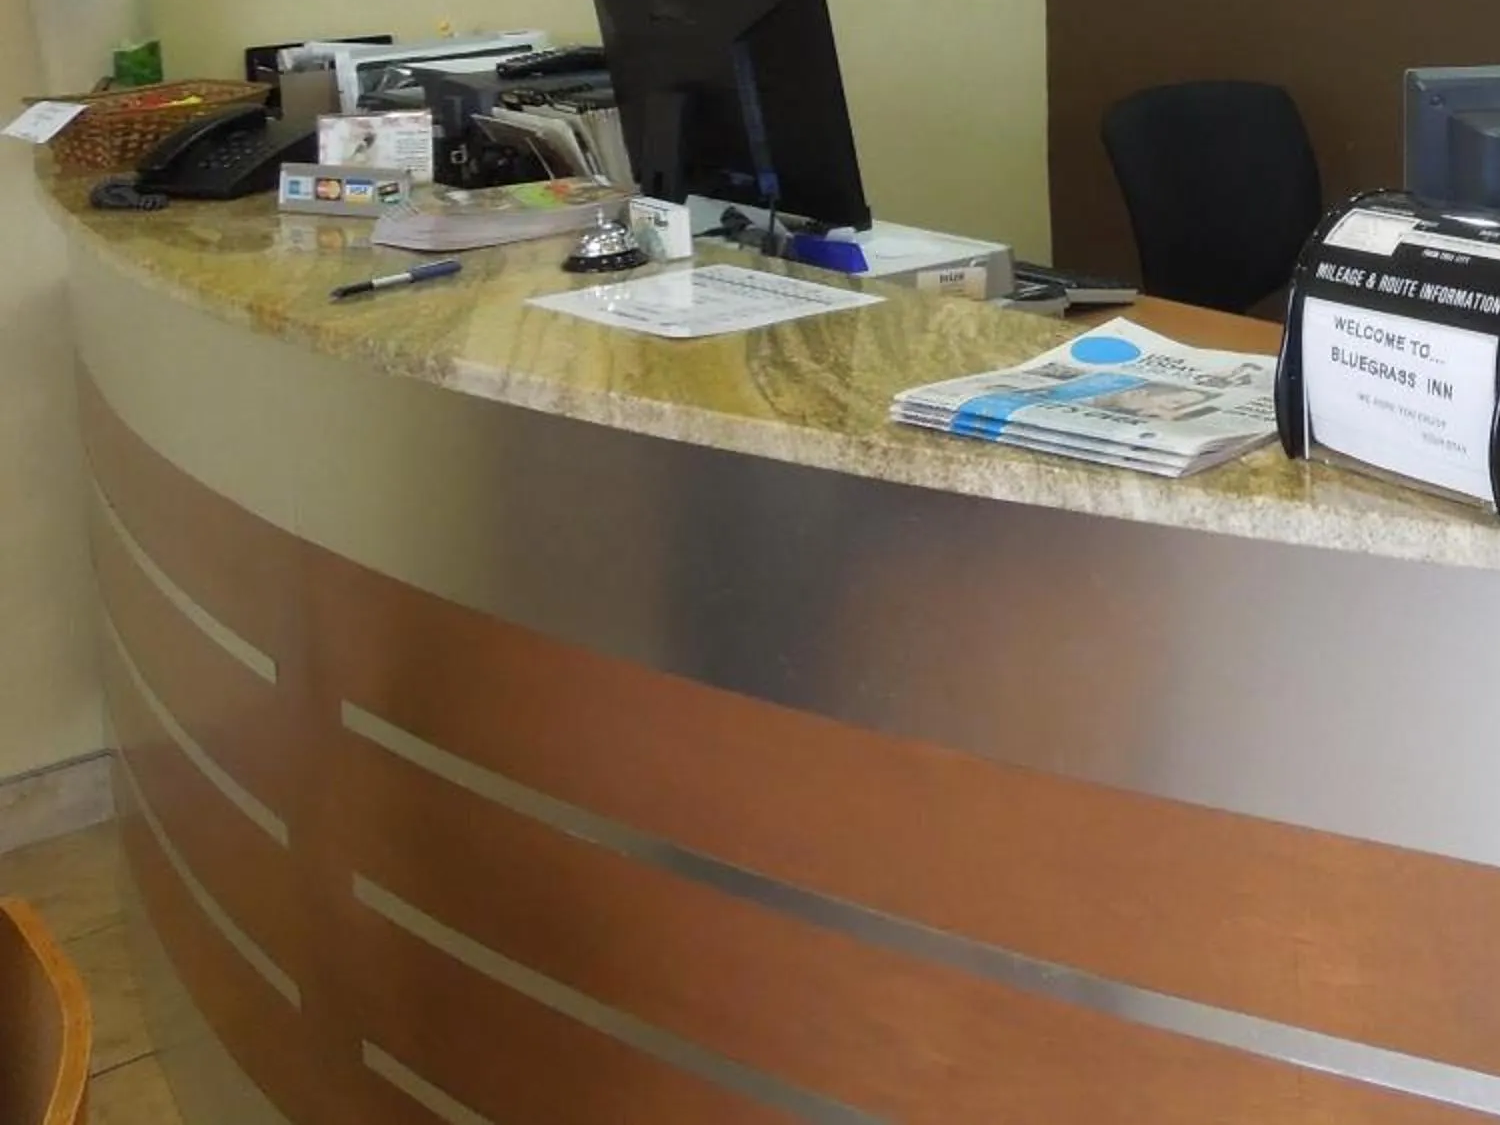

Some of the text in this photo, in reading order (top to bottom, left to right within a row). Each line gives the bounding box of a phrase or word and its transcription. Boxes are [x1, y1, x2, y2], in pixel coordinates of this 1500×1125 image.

[1316, 261, 1367, 288] MILEAGE
[1366, 273, 1376, 289] &
[1378, 274, 1419, 298] ROUTE
[1334, 315, 1446, 364] WELCOME TO...
[1331, 346, 1453, 400] BLUEGRASS INN
